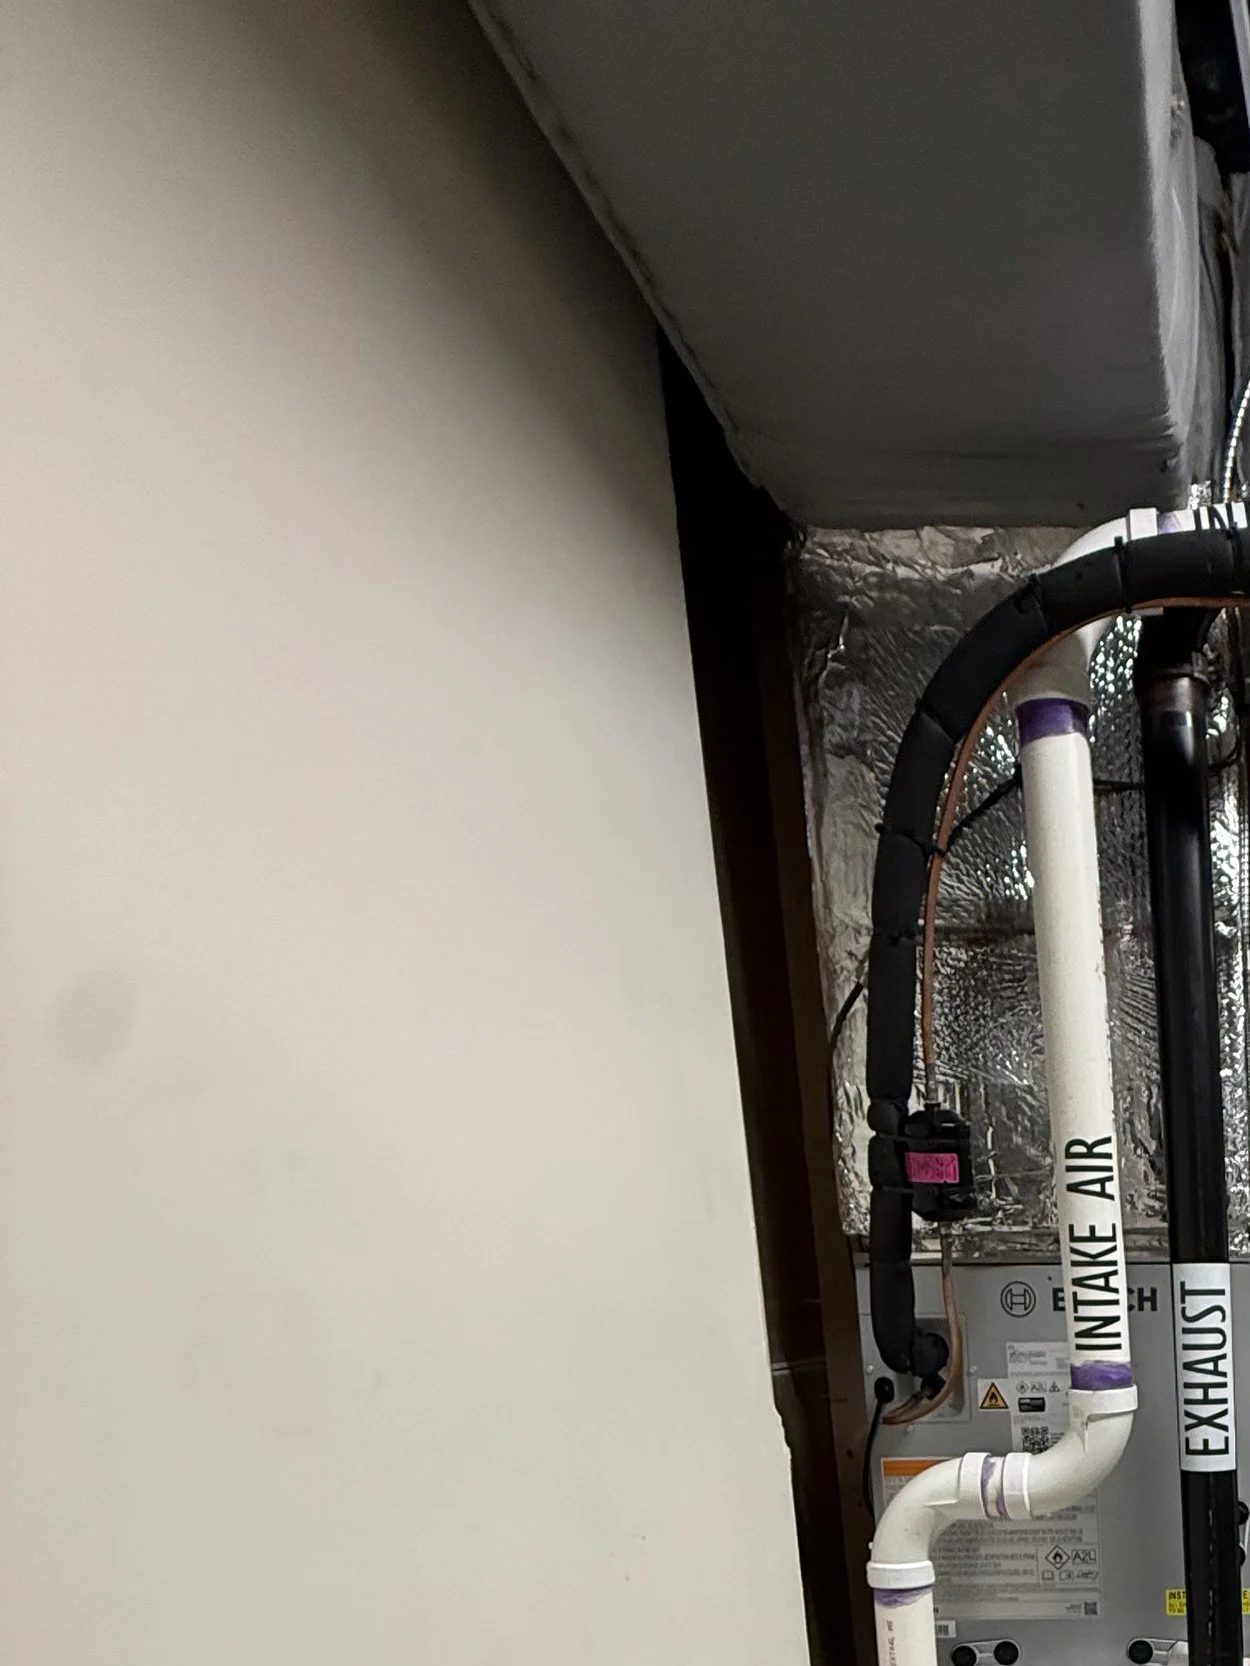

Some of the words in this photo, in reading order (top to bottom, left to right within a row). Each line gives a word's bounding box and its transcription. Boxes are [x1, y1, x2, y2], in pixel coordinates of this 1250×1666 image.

[1064, 1135, 1115, 1202] AIR
[1068, 1222, 1123, 1351] INTAKE
[1180, 1280, 1231, 1456] EXHAUST
[1073, 1550, 1096, 1561] A2L
